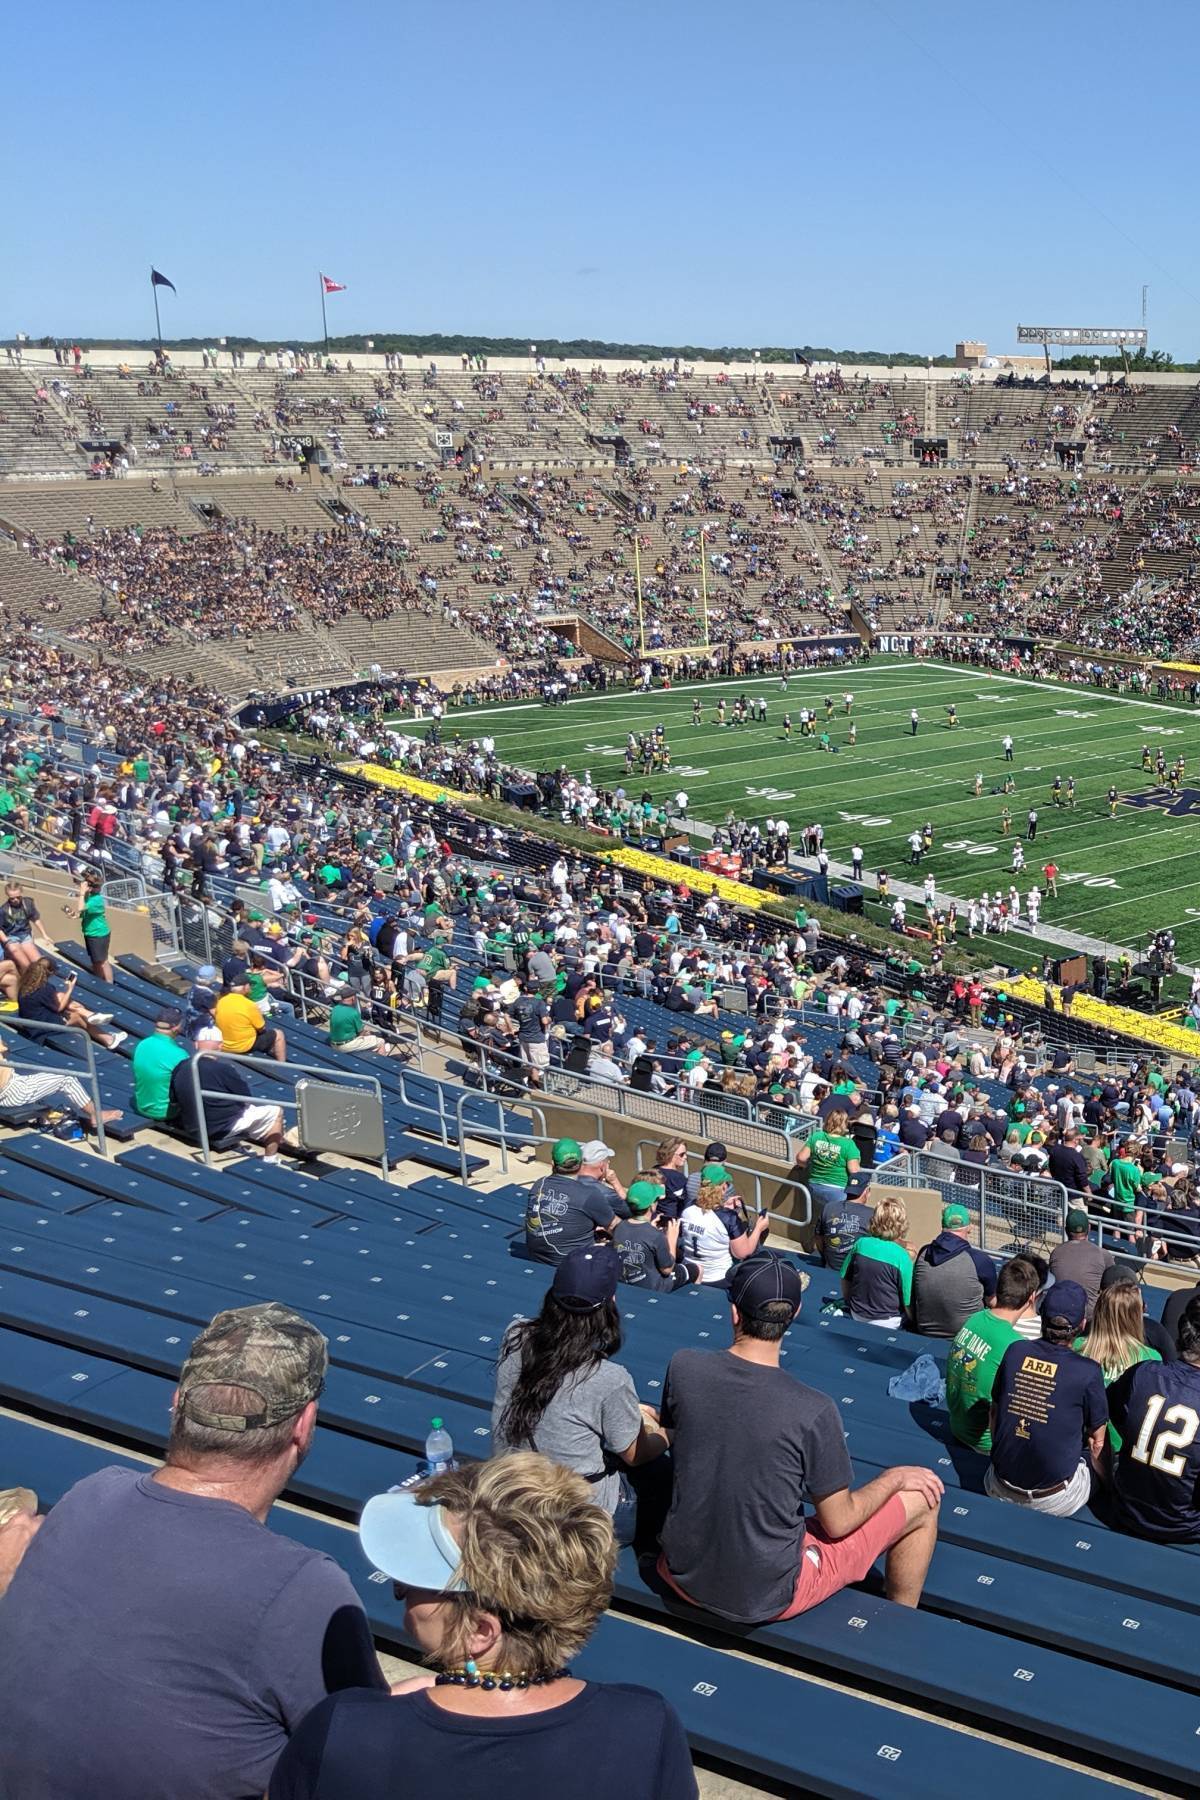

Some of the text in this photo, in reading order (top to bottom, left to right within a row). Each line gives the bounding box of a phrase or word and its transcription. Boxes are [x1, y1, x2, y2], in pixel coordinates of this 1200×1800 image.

[839, 811, 892, 827] 40
[942, 840, 998, 855] 50
[1059, 872, 1117, 888] 40
[687, 1222, 705, 1236] IRISH
[967, 1331, 992, 1362] DAME
[1025, 1359, 1053, 1376] ARA
[1130, 1393, 1200, 1478] 12
[849, 1618, 866, 1627] 25
[1123, 1620, 1139, 1629] 24
[1015, 1670, 1033, 1680] 24
[695, 1683, 714, 1696] 26
[880, 1746, 899, 1760] 25
